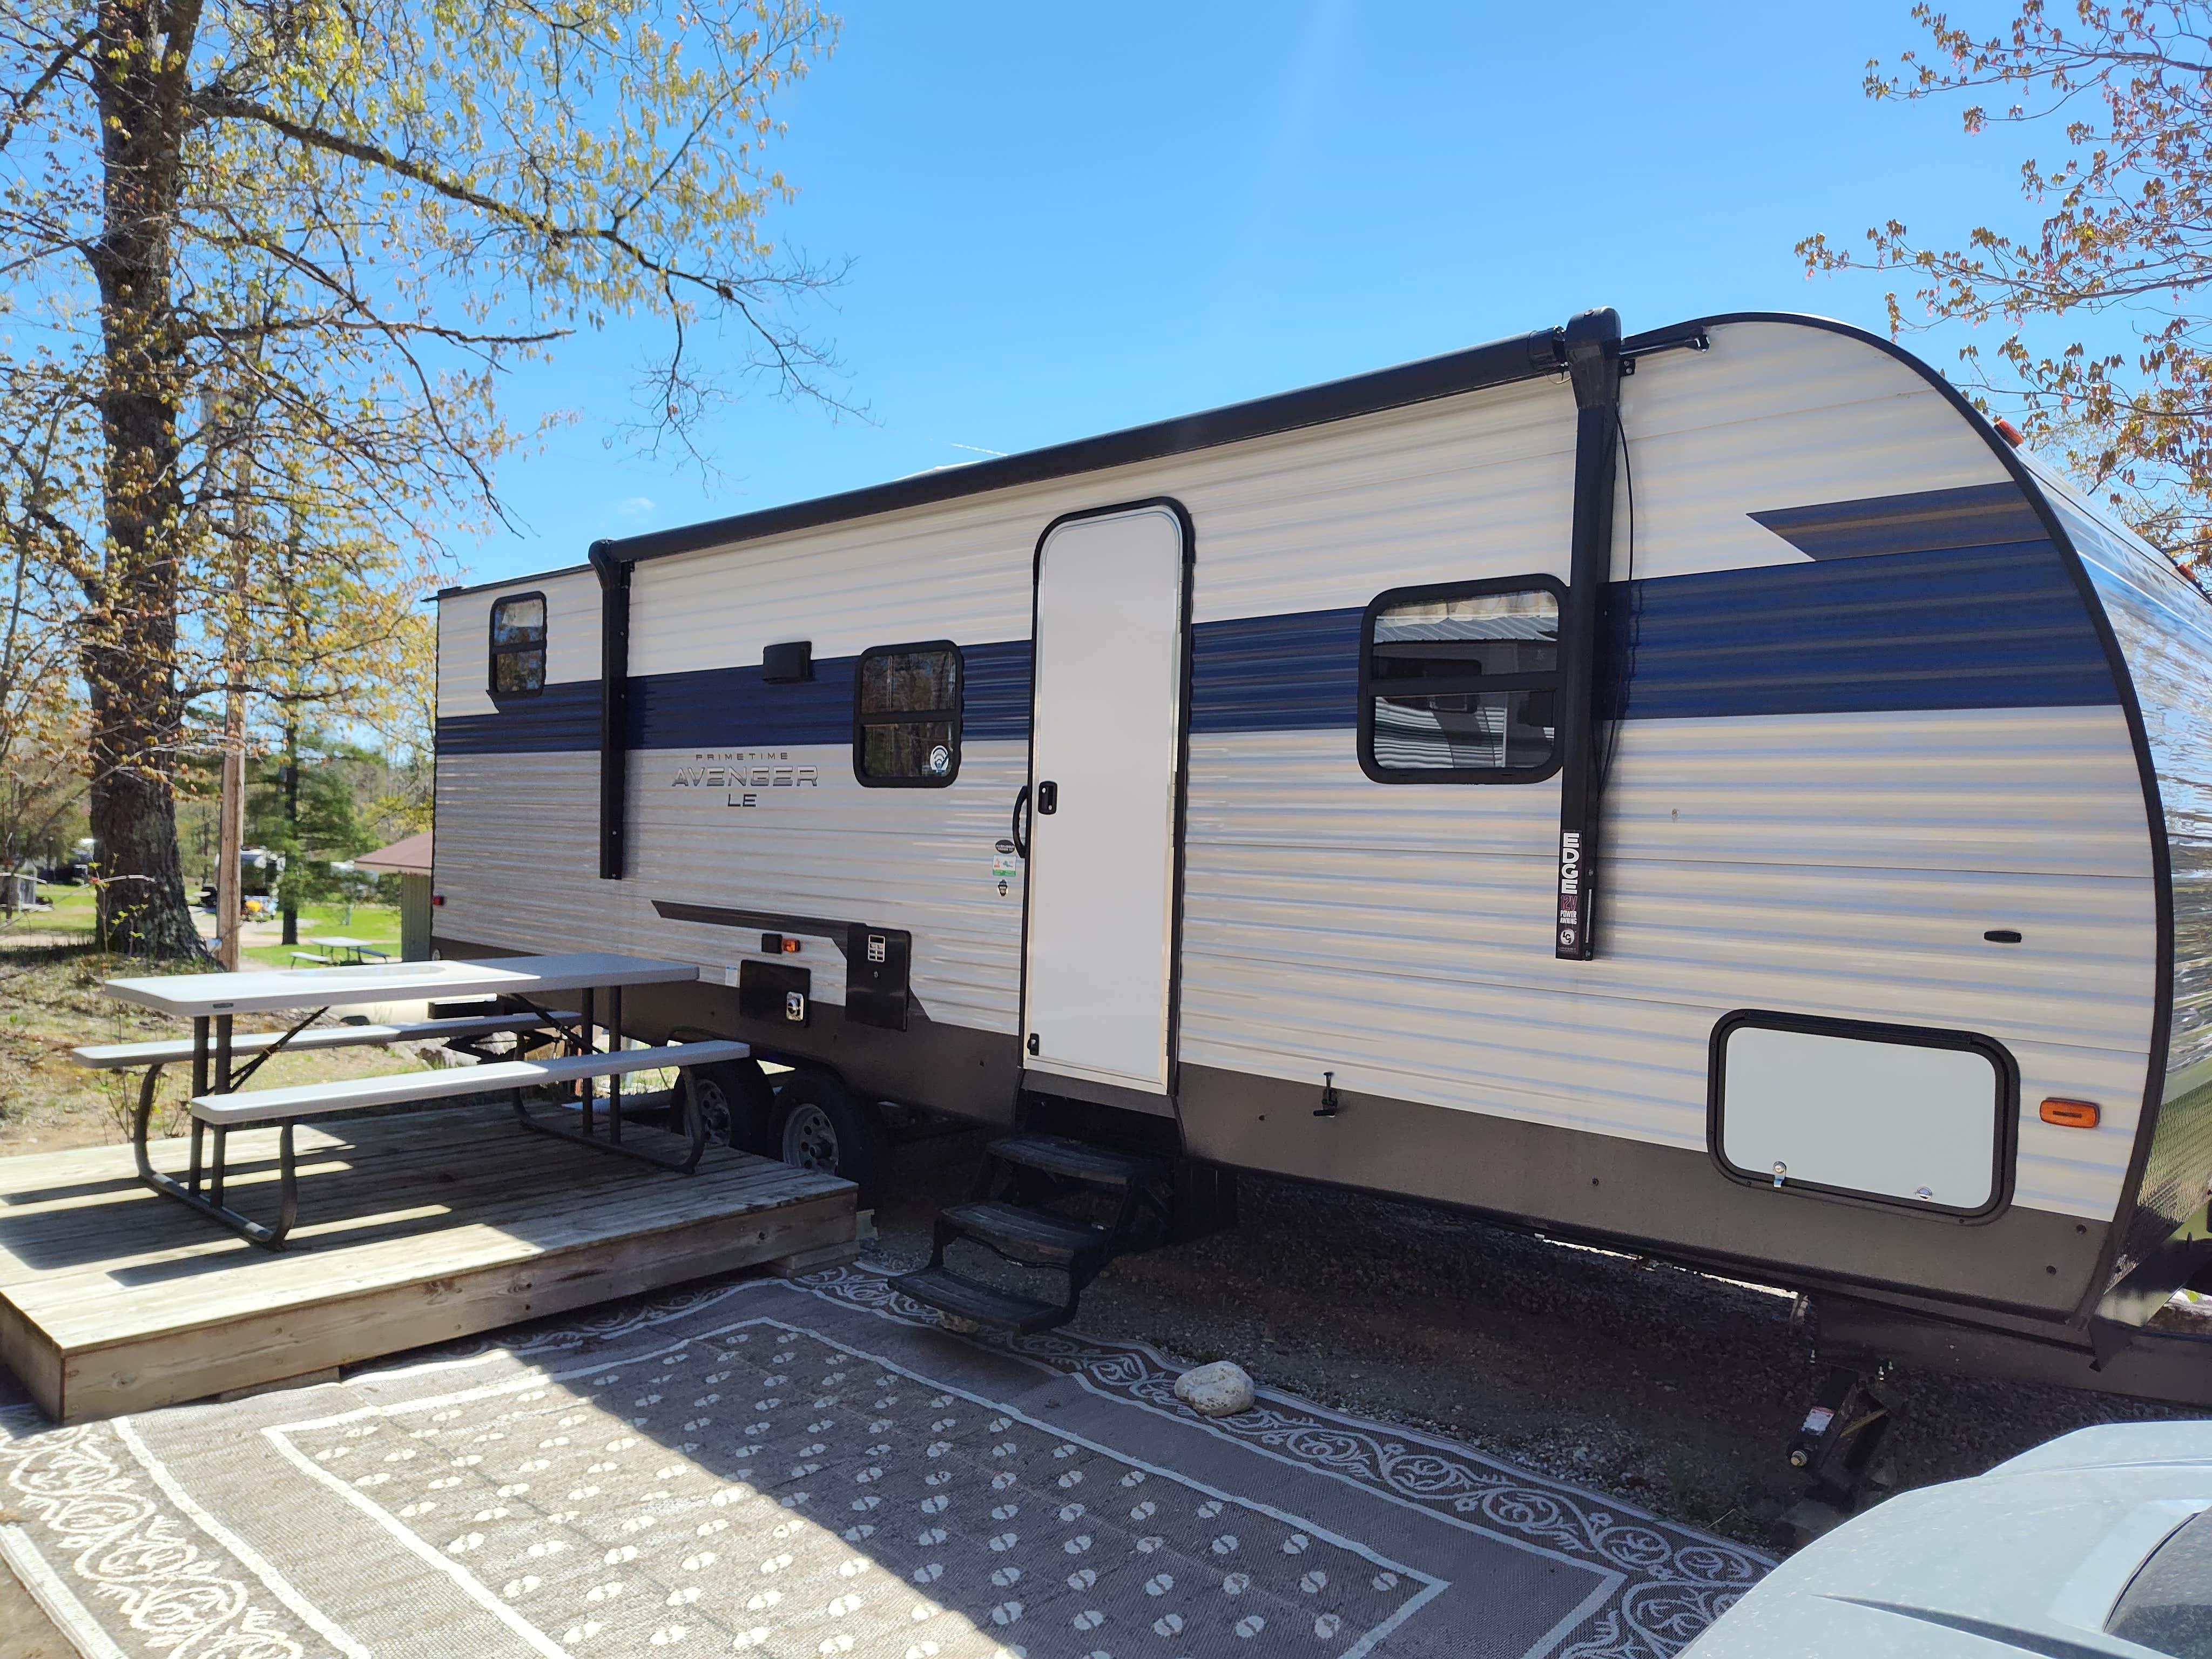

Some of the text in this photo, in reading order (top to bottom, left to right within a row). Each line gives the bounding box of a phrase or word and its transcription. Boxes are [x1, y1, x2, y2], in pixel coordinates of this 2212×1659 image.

[696, 752, 788, 760] PRIMETIME
[672, 765, 818, 786] AVENGER
[727, 793, 757, 807] LE
[1561, 833, 1580, 894] EDGE
[1560, 895, 1577, 911] 12V
